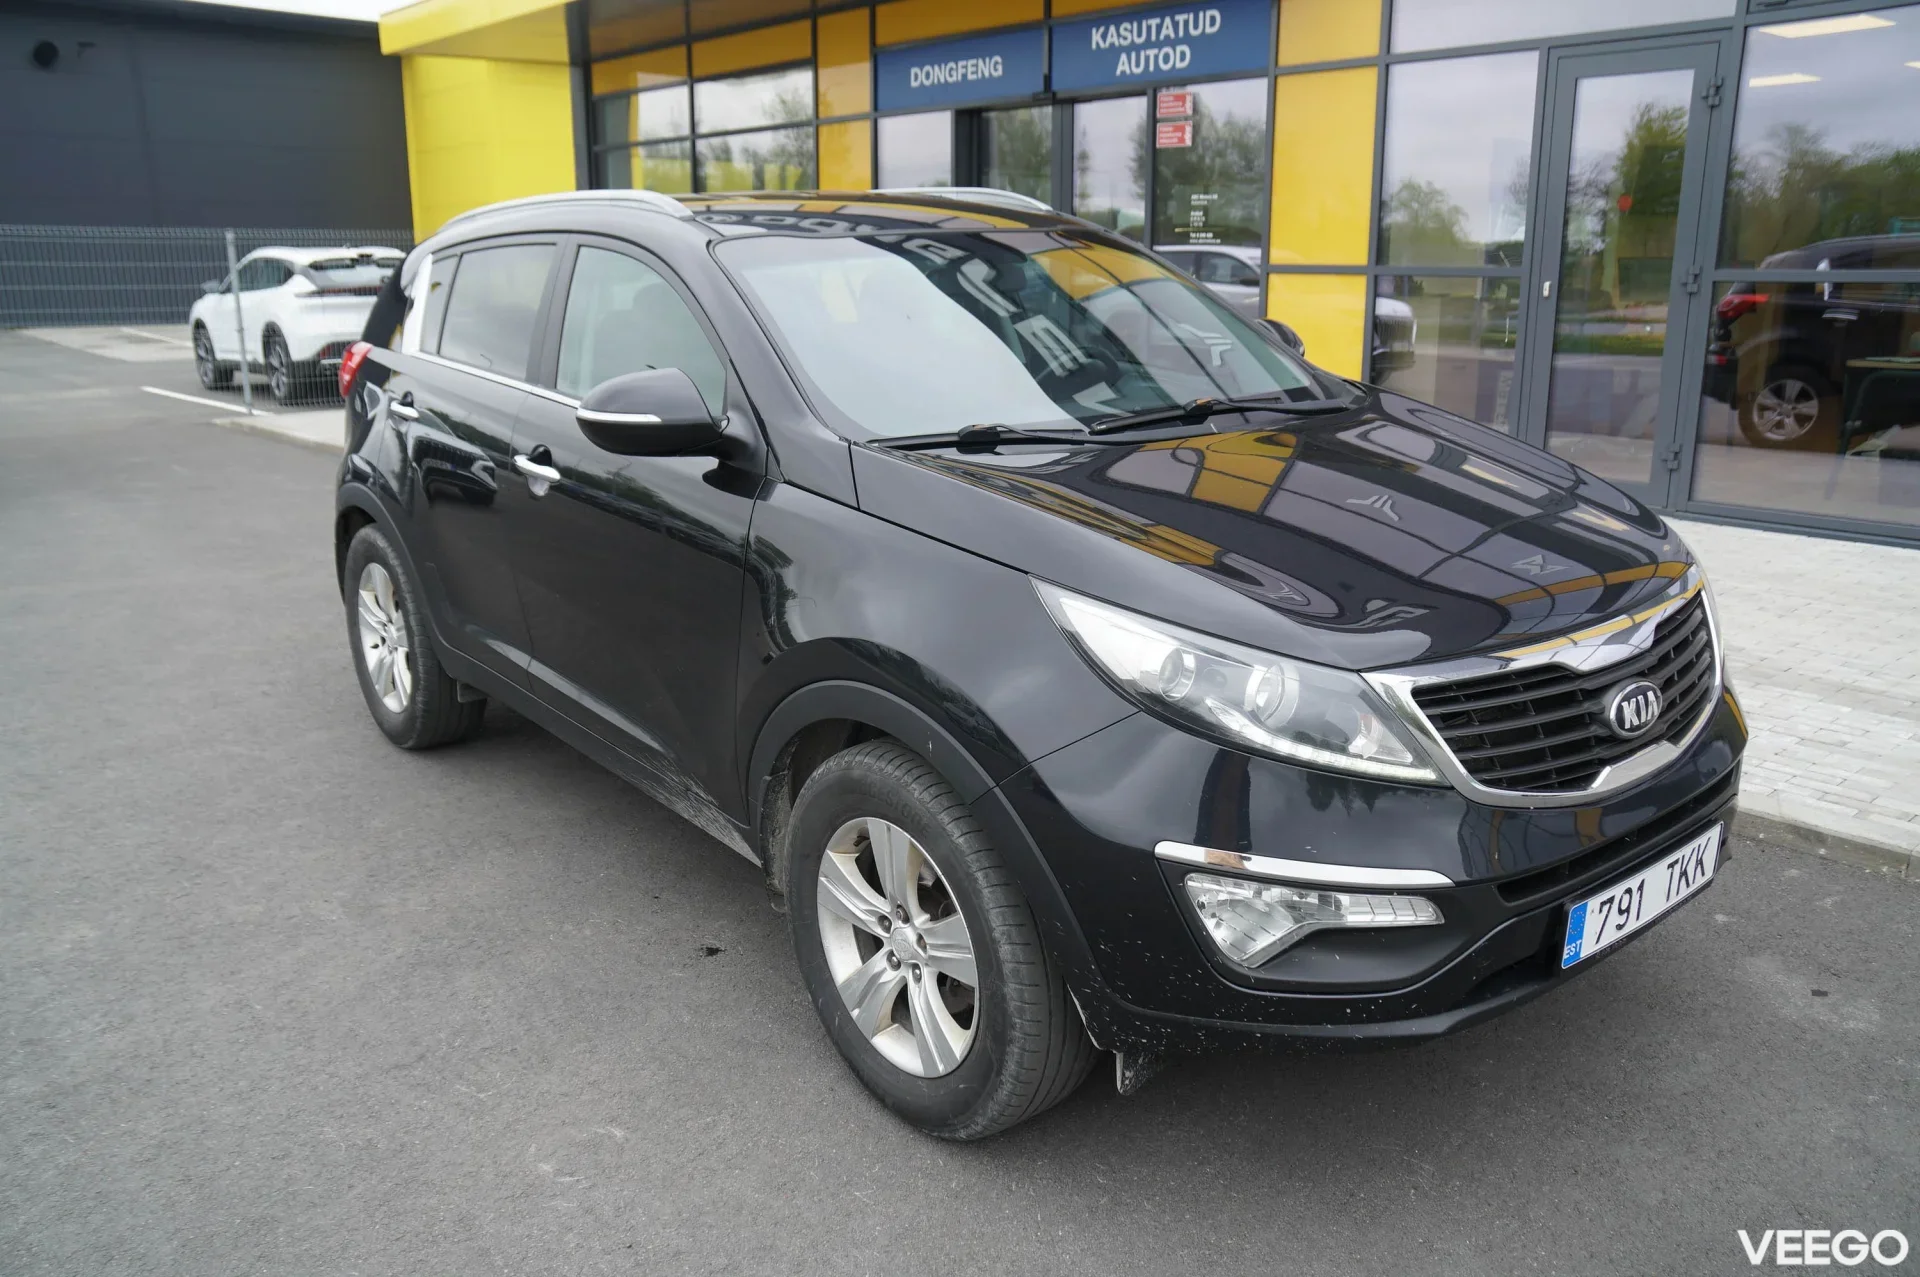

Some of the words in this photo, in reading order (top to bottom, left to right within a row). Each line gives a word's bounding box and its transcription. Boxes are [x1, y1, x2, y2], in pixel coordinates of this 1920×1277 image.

[1091, 8, 1221, 51] KASUTATUD
[910, 55, 1003, 88] DONGFENG
[1115, 44, 1191, 76] AUTOD
[1621, 690, 1658, 729] KIA
[1595, 878, 1645, 945] 791
[1666, 836, 1711, 902] TKK
[1564, 940, 1582, 959] EST
